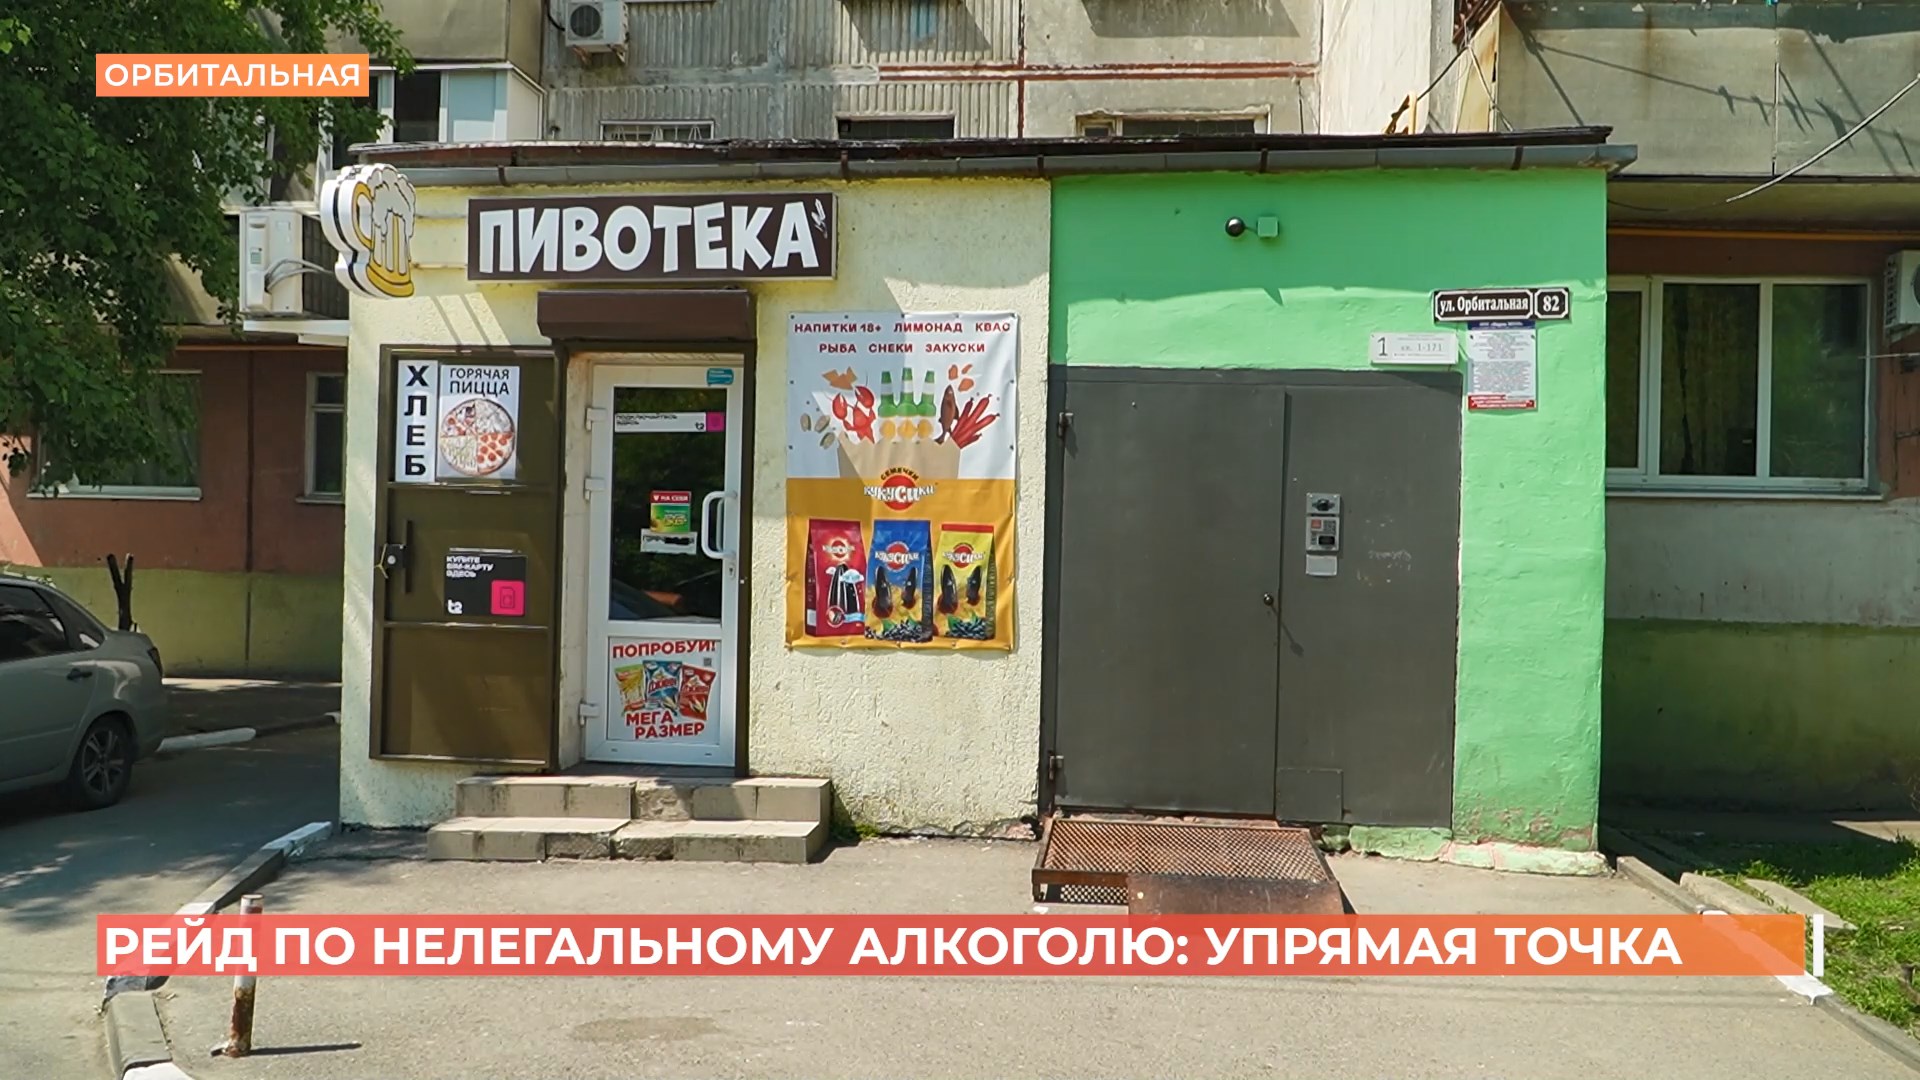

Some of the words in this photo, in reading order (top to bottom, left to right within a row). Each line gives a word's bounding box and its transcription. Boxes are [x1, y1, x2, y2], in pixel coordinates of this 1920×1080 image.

[479, 201, 819, 273] ПИВОТЕКА
[1440, 299, 1455, 316] ул.
[1457, 295, 1529, 315] Орбитальная
[1543, 295, 1560, 312] 82
[794, 323, 858, 333] НАПИТКИ
[860, 323, 882, 333] 18+
[893, 322, 964, 334] ЛИМОНАД
[819, 343, 857, 353] РЫБА
[868, 343, 914, 353] СНЕКИ
[925, 343, 986, 353] ЗАКУСКИ
[1377, 337, 1389, 357] 1
[450, 367, 510, 381] ГОРЯЧАЯ
[449, 381, 510, 398] ПИЦЦА
[403, 365, 430, 477] ХЛЕБ
[880, 467, 919, 480] СЕМЕЧКИ
[446, 555, 481, 564] КУПИТЕ
[447, 599, 463, 614] t2
[626, 710, 674, 727] МЕГА
[634, 723, 705, 740] РАЗМЕР
